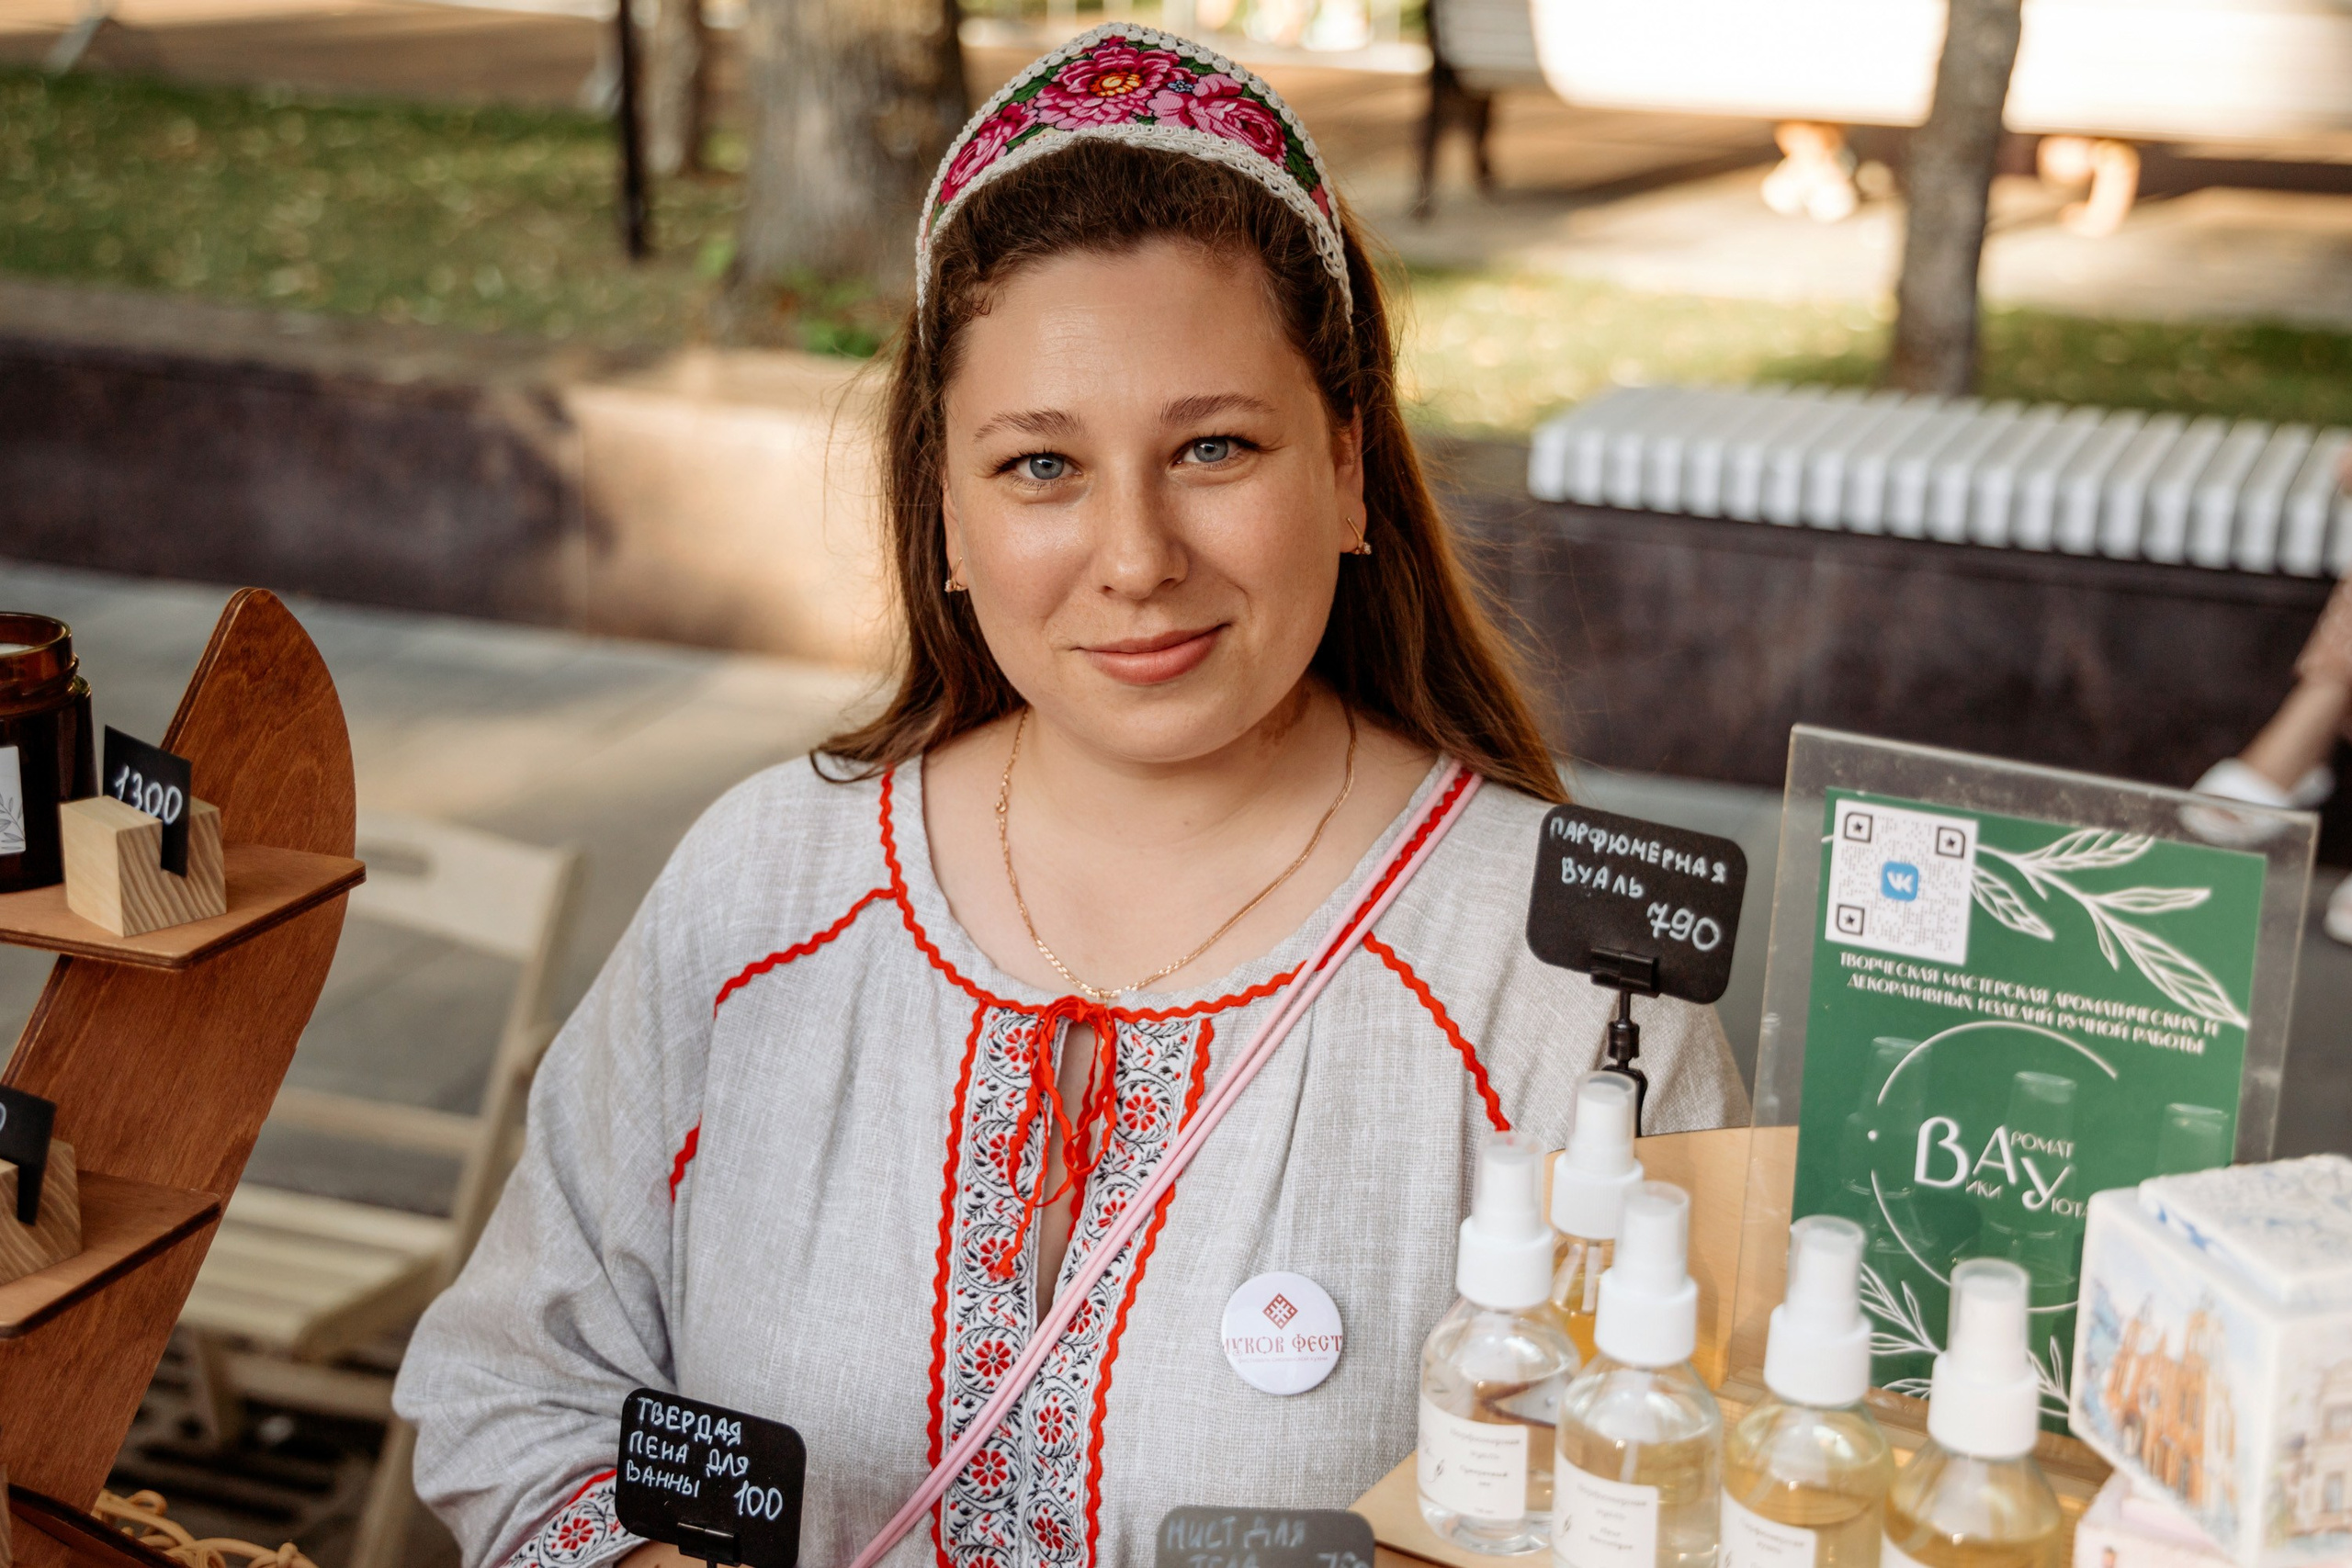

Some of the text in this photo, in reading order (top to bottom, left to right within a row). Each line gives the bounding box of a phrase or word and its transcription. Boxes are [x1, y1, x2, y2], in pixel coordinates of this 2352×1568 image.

[114, 764, 183, 825] 1300
[1549, 817, 1727, 885] ПАРФЮМЕРНАЯ
[1561, 856, 1645, 898] ВУАЛЬ
[1646, 901, 1722, 952] 790
[1839, 951, 2220, 1039] ТВОРЧЕСКАЯ МАСТЕРСКАЯ АРОМАТИЧЕСКИХ И
[1846, 972, 2205, 1055] ДЕКОРАТИВНЫХ ИЗДЕЛИЙ РУЧНОЙ РАБОТЫ
[629, 1430, 689, 1464] ПЕНА
[637, 1396, 741, 1447] ТВЕРДАЯ
[626, 1459, 701, 1498] ВАННЫ
[733, 1479, 784, 1521] 100
[1166, 1516, 1306, 1550] МИСТ ДЛЯ
